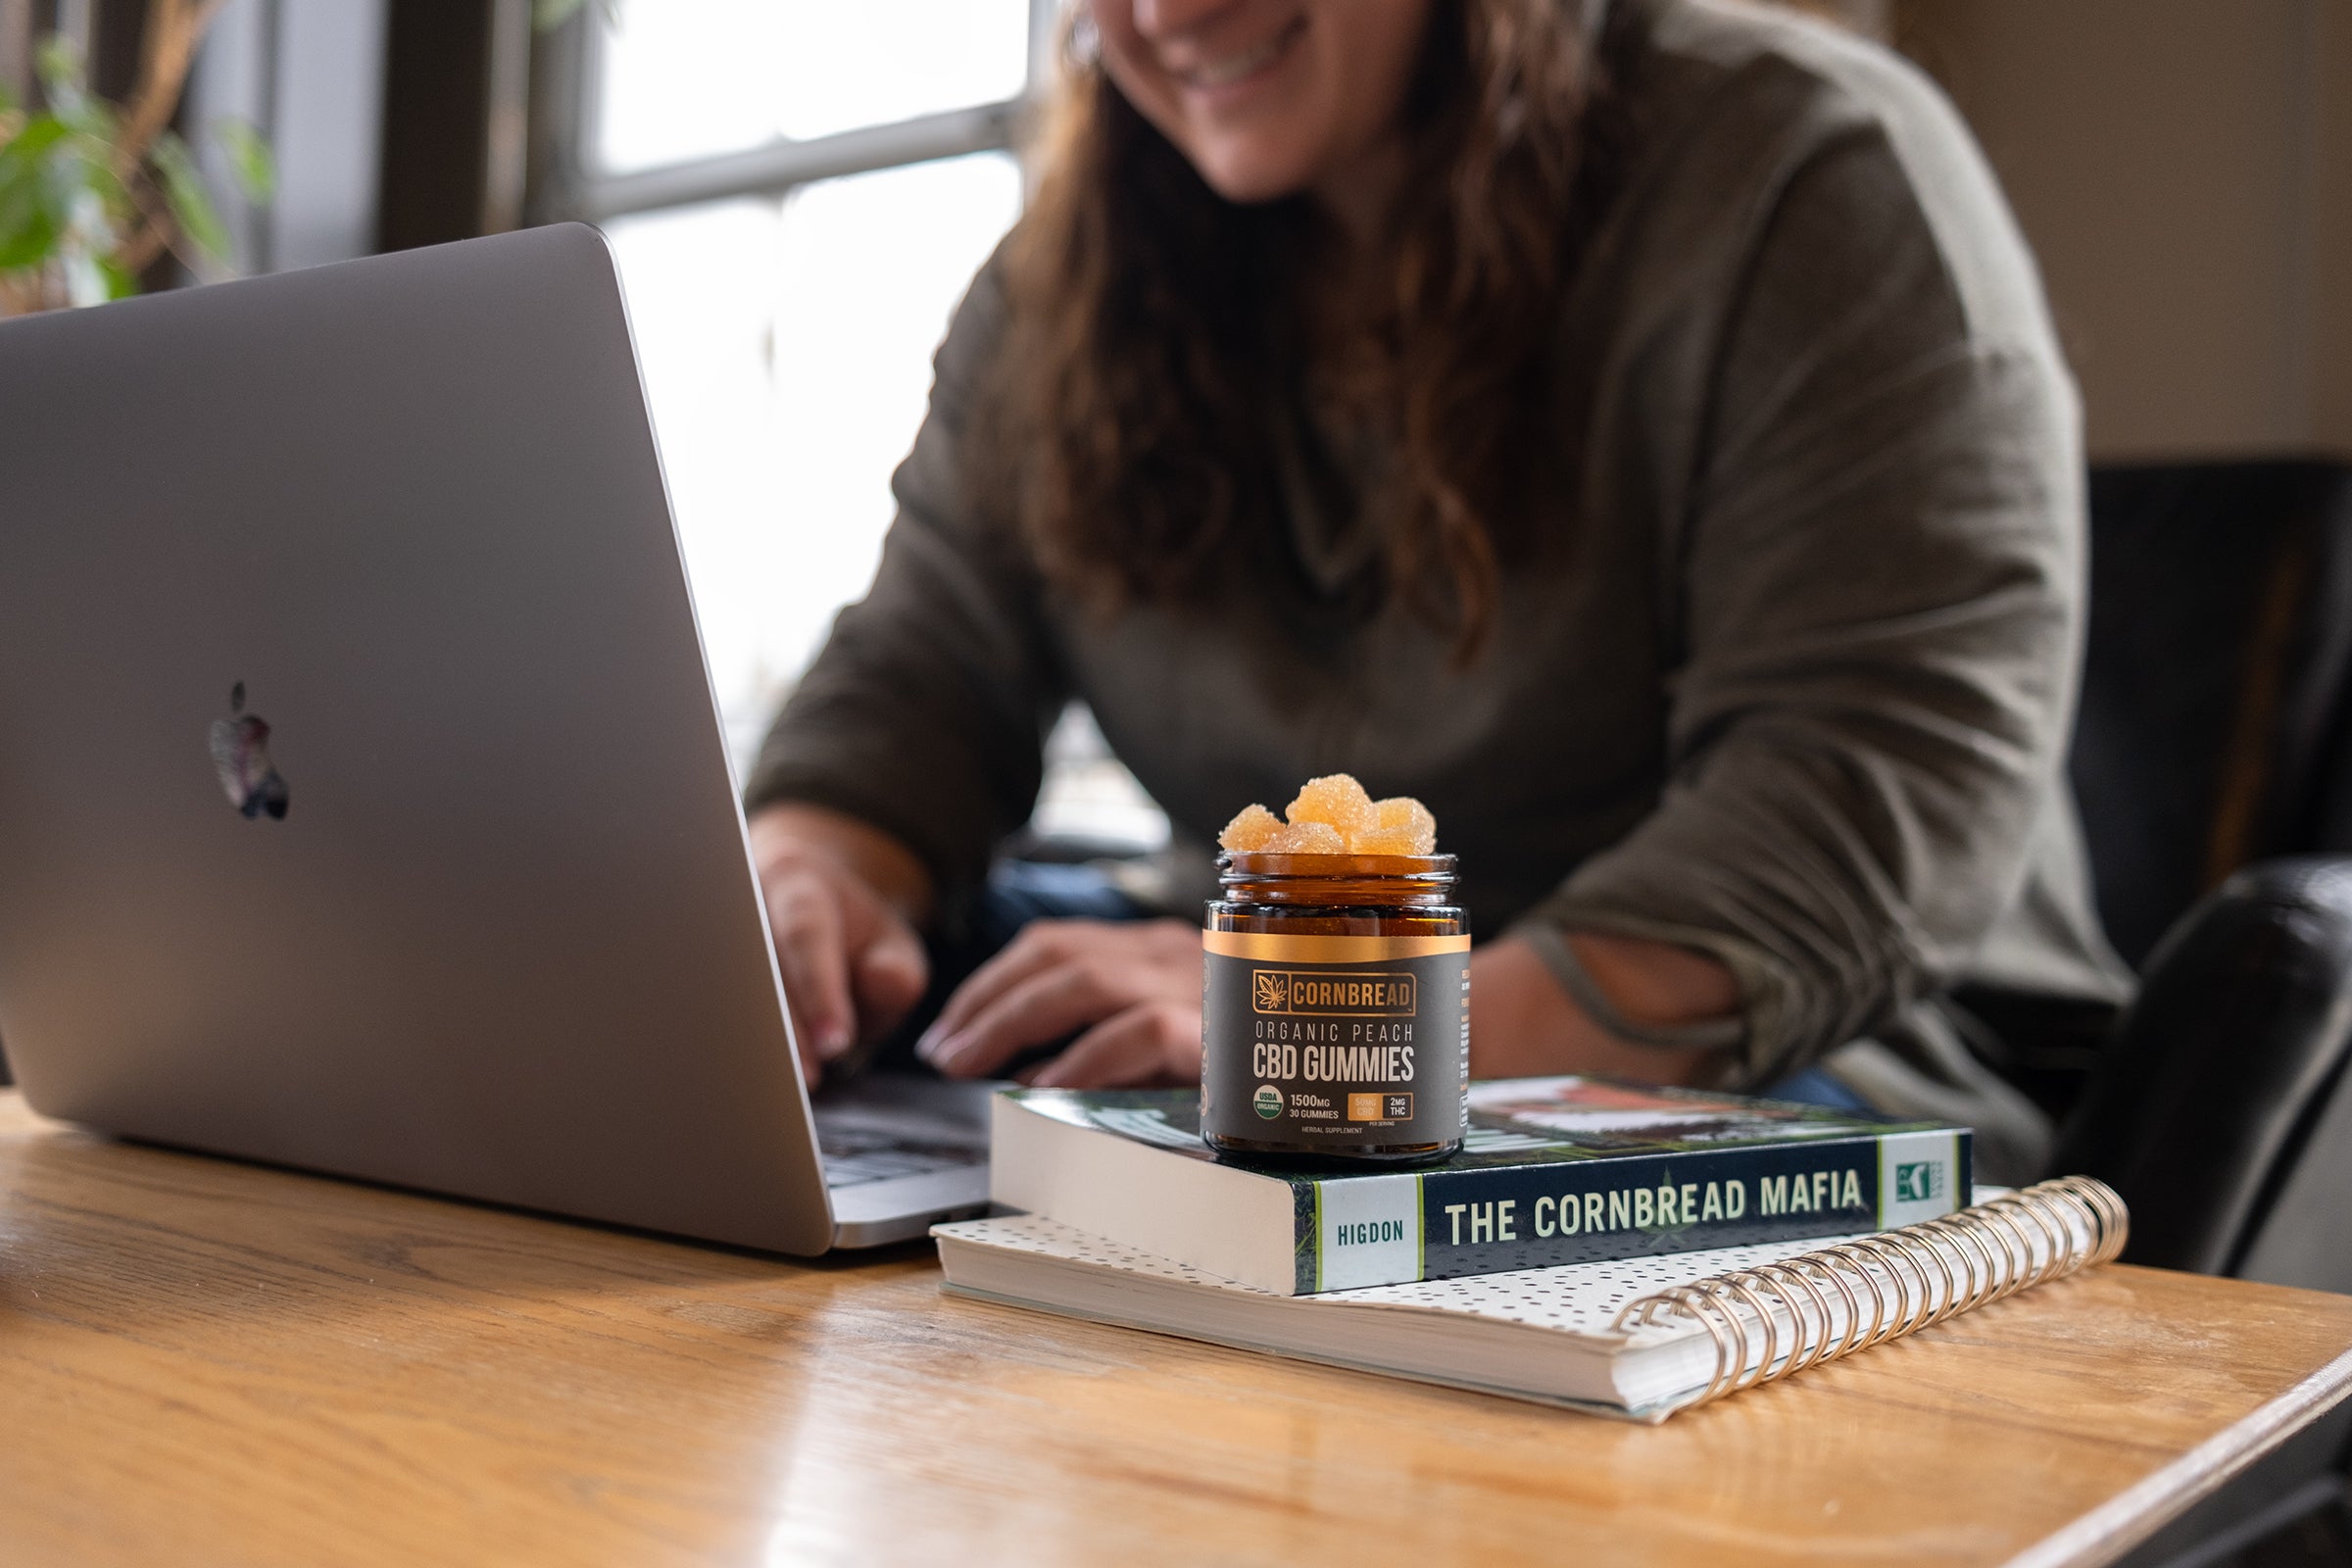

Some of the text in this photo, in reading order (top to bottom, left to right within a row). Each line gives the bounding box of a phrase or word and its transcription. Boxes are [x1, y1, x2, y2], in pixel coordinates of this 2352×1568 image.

[1293, 981, 1410, 1005] CORNBREAD
[1255, 1020, 1412, 1043] ORGANIC PEACH
[1253, 1042, 1298, 1080] CBD
[1303, 1045, 1415, 1082] GUMMIES
[1259, 1092, 1278, 1102] USDA
[1290, 1094, 1331, 1107] 1500MG
[1390, 1097, 1406, 1106] 2MG
[1256, 1102, 1280, 1111] ORGANIC
[1390, 1106, 1406, 1116] THC
[1289, 1108, 1340, 1119] 30 GUMMIES
[1445, 1169, 1862, 1246] THE CORNBREAD MAFIA
[1338, 1219, 1403, 1247] HIGDON
